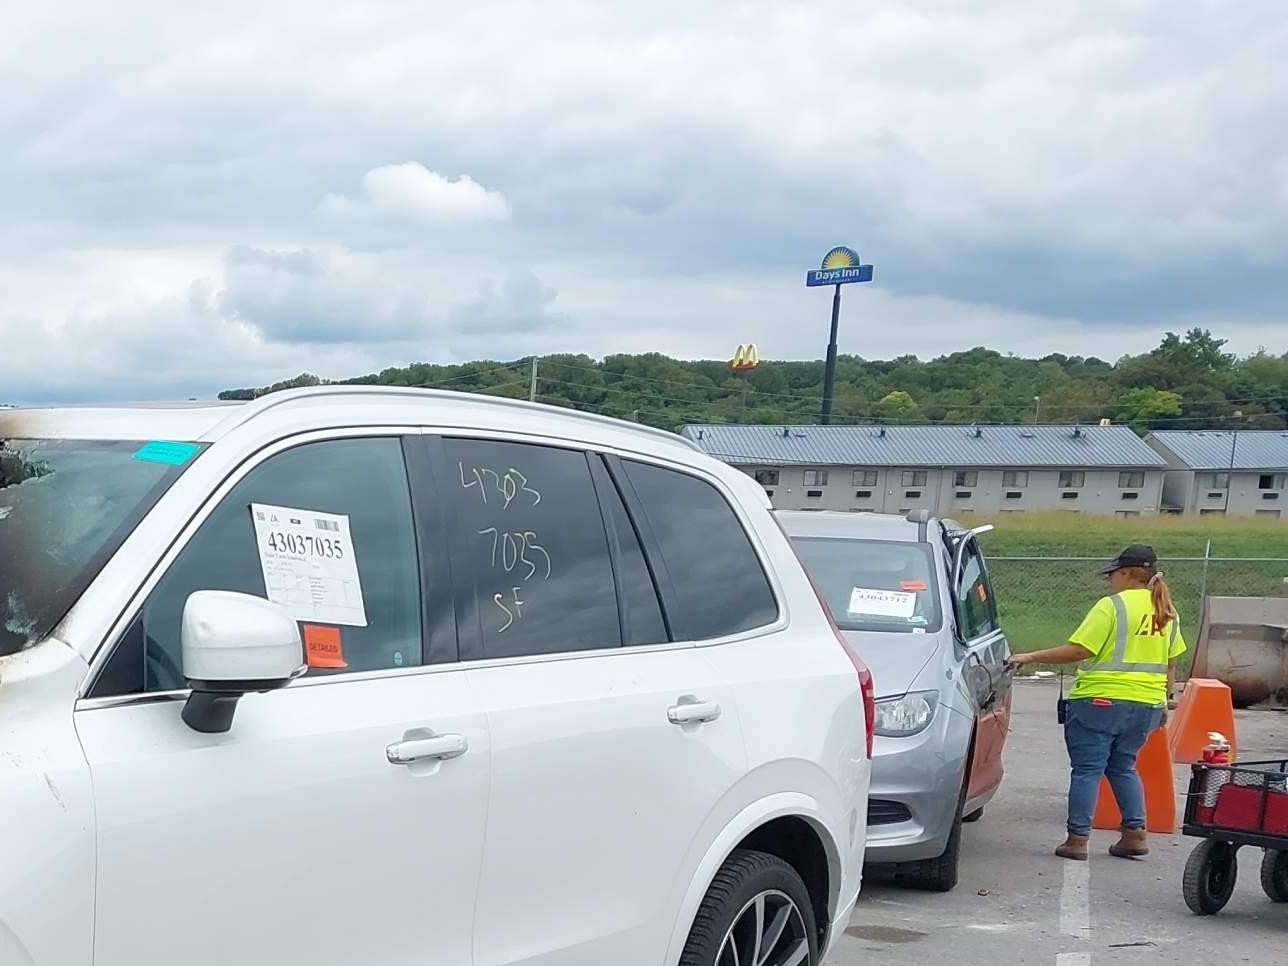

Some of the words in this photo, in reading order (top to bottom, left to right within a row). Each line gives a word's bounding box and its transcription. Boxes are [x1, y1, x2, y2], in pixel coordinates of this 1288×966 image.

[815, 271, 841, 280] Days
[841, 268, 859, 277] Inn
[268, 531, 344, 559] 43037035
[476, 527, 551, 580] 7035
[494, 586, 524, 632] SF
